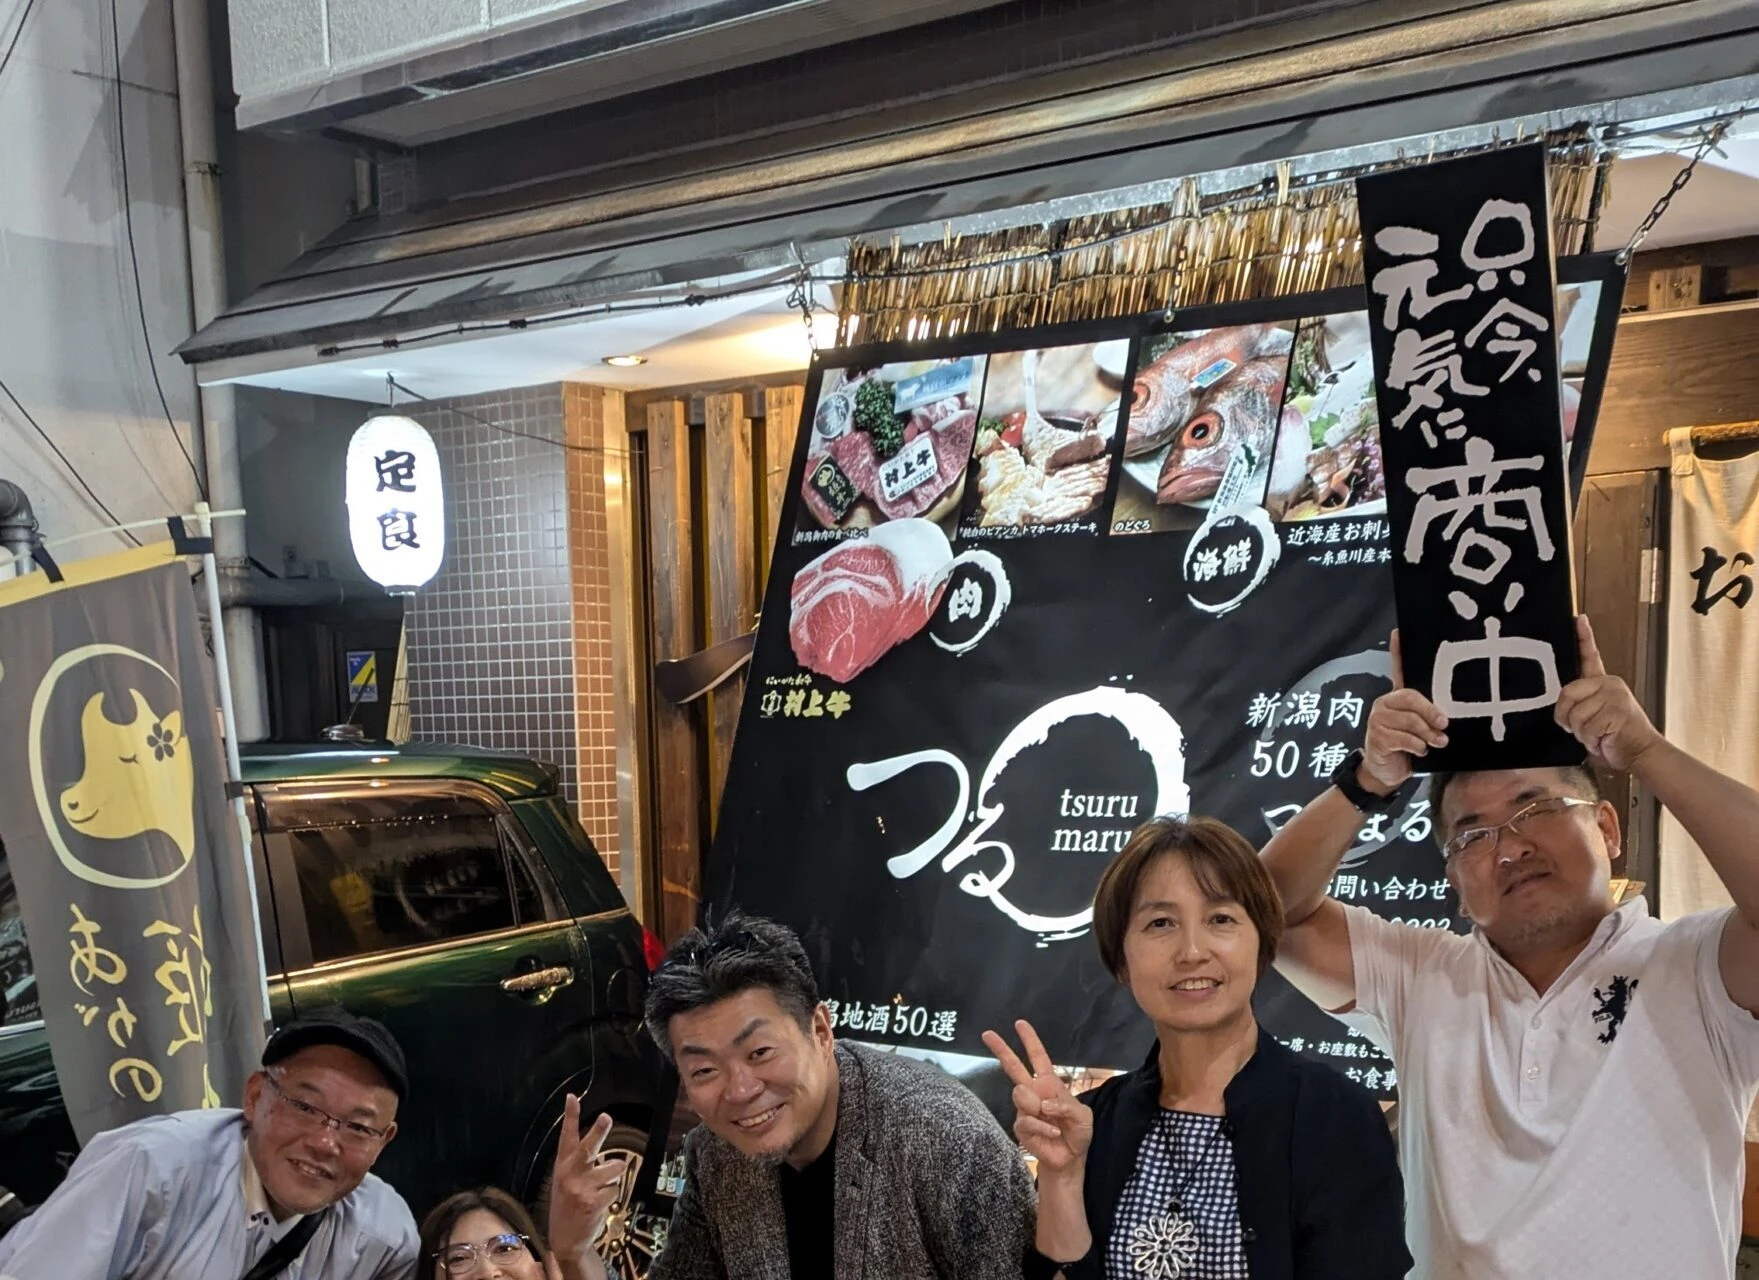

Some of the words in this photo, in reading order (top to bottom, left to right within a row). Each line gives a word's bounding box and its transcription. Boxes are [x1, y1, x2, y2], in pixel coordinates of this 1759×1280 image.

[1372, 225, 1489, 449] 元気に
[1114, 519, 1152, 533] のどぐろ
[1192, 536, 1254, 583] 海鮮
[948, 577, 983, 623] 肉
[1404, 436, 1562, 742] 商い中
[1689, 545, 1757, 617] お
[783, 688, 852, 719] 村上牛
[1245, 691, 1365, 730] 新潟肉
[1059, 788, 1139, 818] tsuru
[1050, 828, 1133, 853] maru
